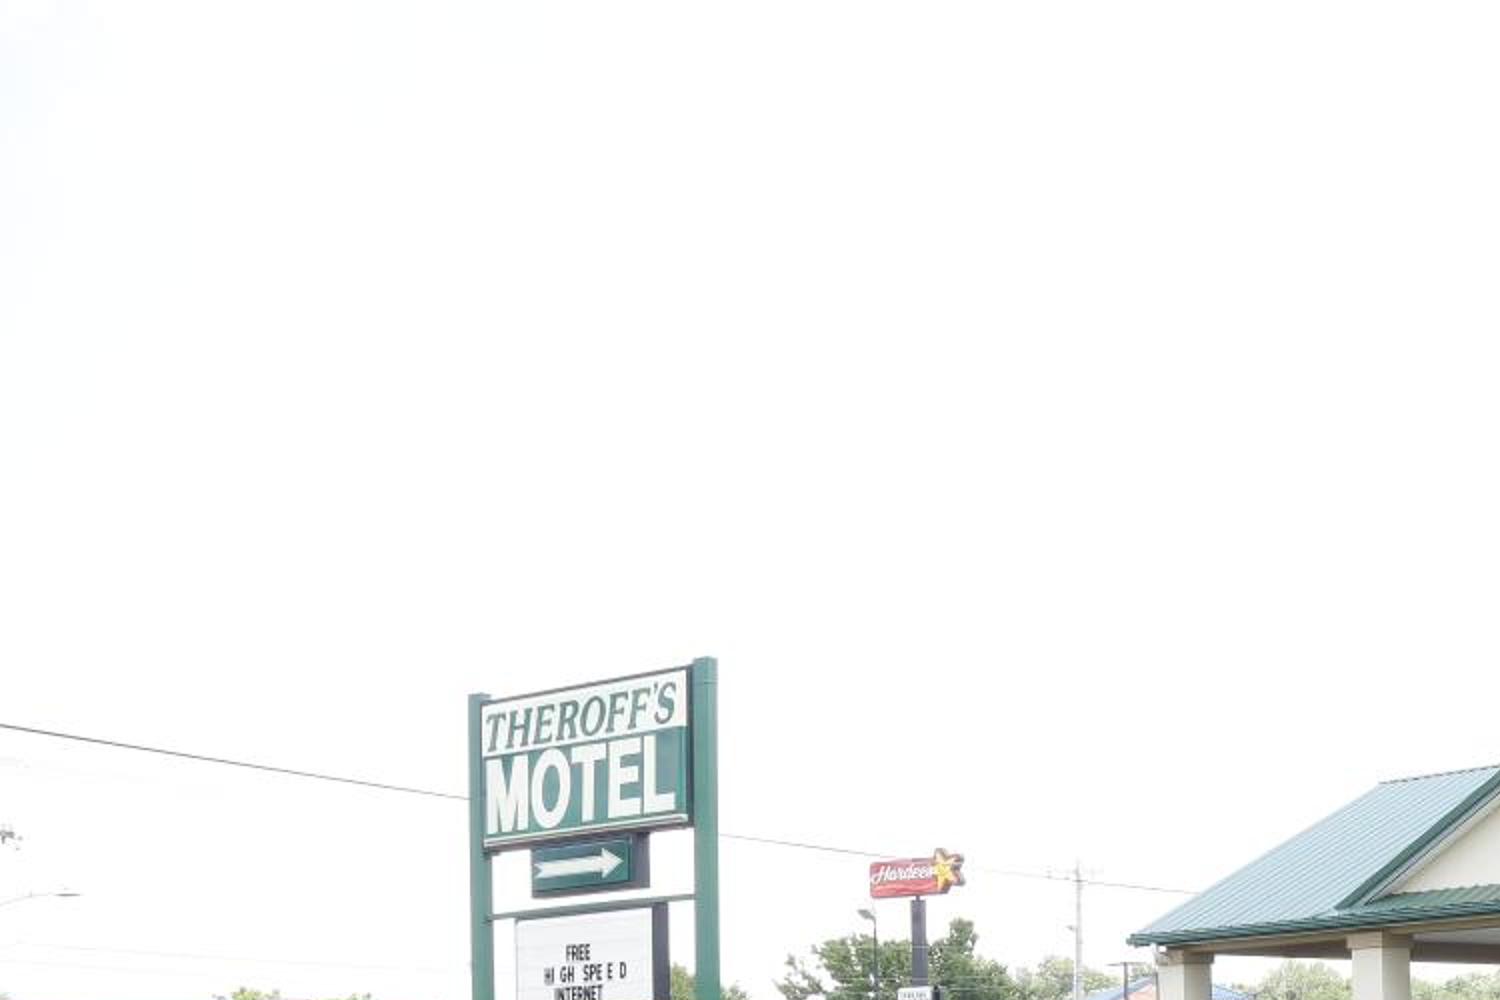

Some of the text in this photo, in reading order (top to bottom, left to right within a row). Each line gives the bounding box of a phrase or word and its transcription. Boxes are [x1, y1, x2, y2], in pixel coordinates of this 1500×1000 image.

[486, 682, 677, 753] THEROFF'S
[485, 734, 676, 835] MOTEL
[565, 943, 591, 962] FREE
